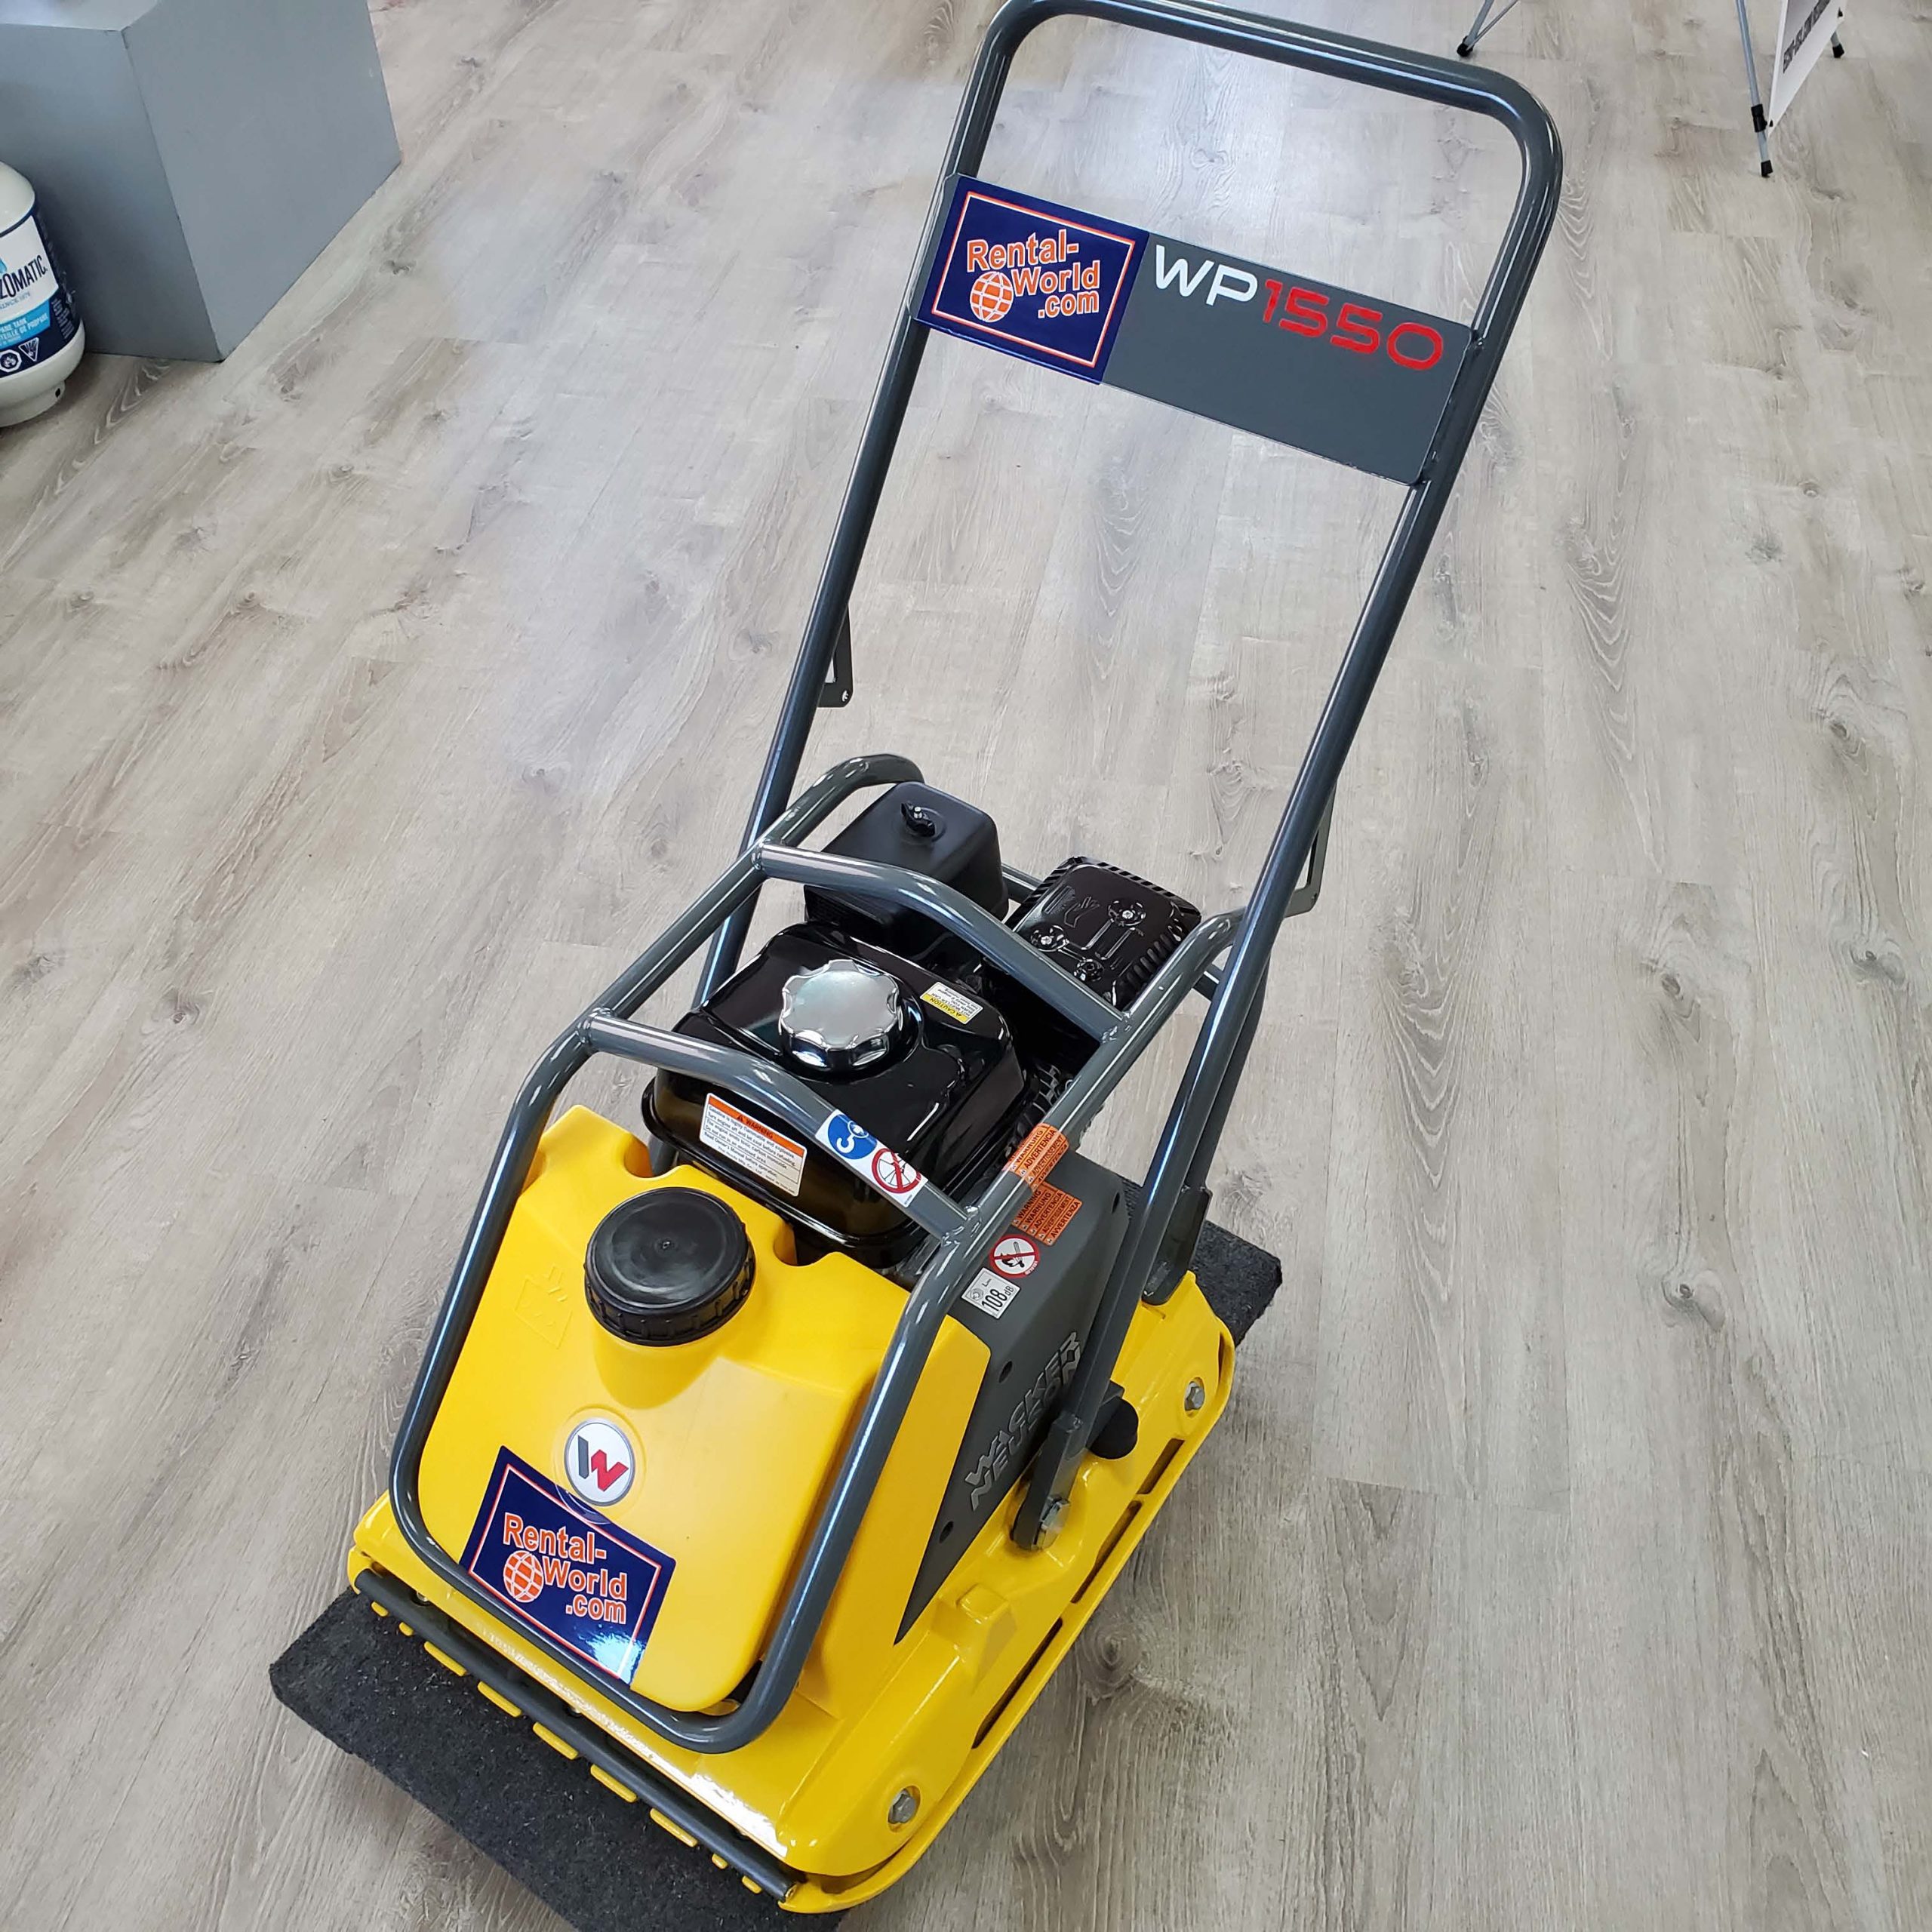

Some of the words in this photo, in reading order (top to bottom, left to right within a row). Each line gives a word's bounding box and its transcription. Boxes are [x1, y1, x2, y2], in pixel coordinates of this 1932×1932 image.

[967, 229, 1079, 272] Rental-
[1011, 260, 1100, 297] World
[1038, 291, 1100, 319] .com
[1155, 245, 1444, 371] WP1550
[929, 997, 956, 1014] CAUTION
[745, 1118, 773, 1139] WARNING
[1024, 1130, 1055, 1168] ADVERTENCIA
[1017, 1189, 1041, 1219] WARNING
[1025, 1192, 1051, 1223] WARNUNG
[1034, 1192, 1063, 1229] ADVERTENCIA
[1051, 1201, 1081, 1238] AVVERTENZA
[982, 1288, 1008, 1312] 108
[1004, 1285, 1014, 1296] dB
[964, 1331, 1079, 1485] WACKER
[503, 1512, 608, 1565] Rental-
[542, 1556, 628, 1601] World
[565, 1593, 627, 1625] .com
